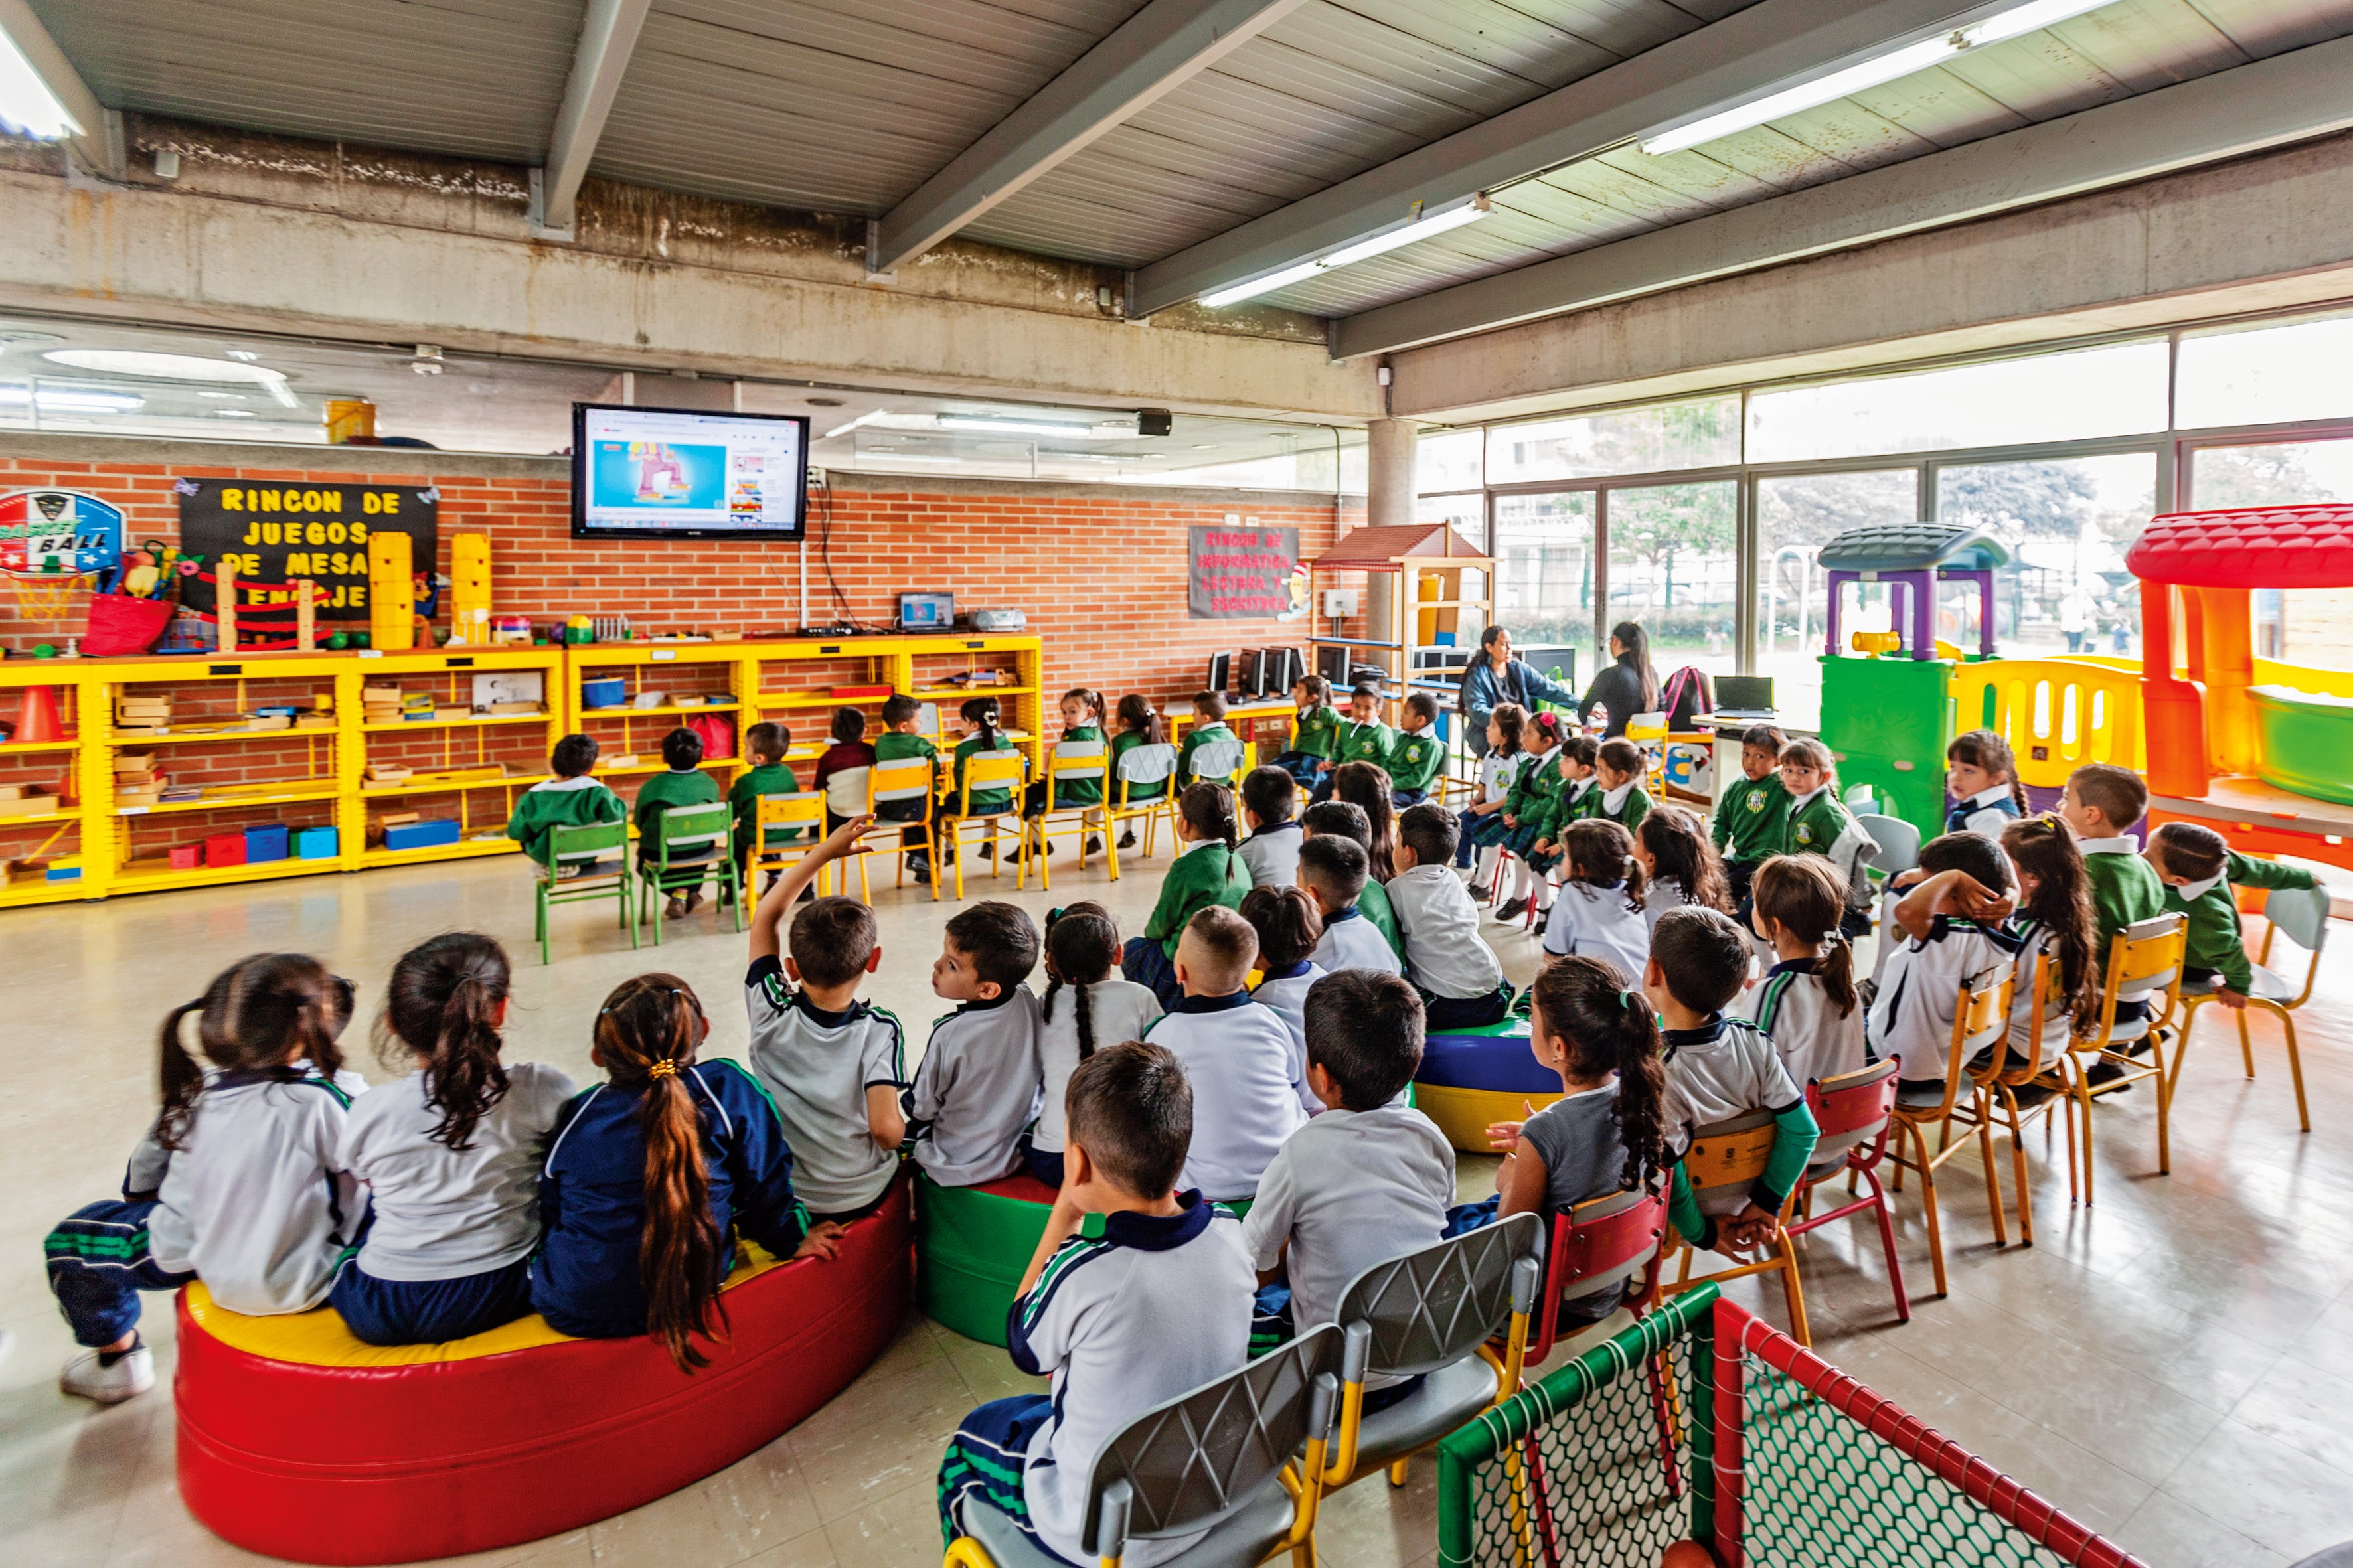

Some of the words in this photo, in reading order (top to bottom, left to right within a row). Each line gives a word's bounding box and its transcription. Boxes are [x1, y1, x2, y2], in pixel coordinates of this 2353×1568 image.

[221, 488, 342, 513] RINCON
[363, 491, 400, 514] DE
[242, 521, 368, 546] JUEGOS
[1206, 532, 1258, 548] RINCON
[1265, 533, 1283, 548] DE
[39, 534, 108, 552] BALL
[221, 552, 261, 576] DE
[285, 552, 368, 576] MESA
[1198, 553, 1290, 570] INFORMATICA
[1202, 575, 1265, 591] LECTURA
[1273, 575, 1281, 591] Y
[1212, 596, 1287, 612] ESCRITURA
